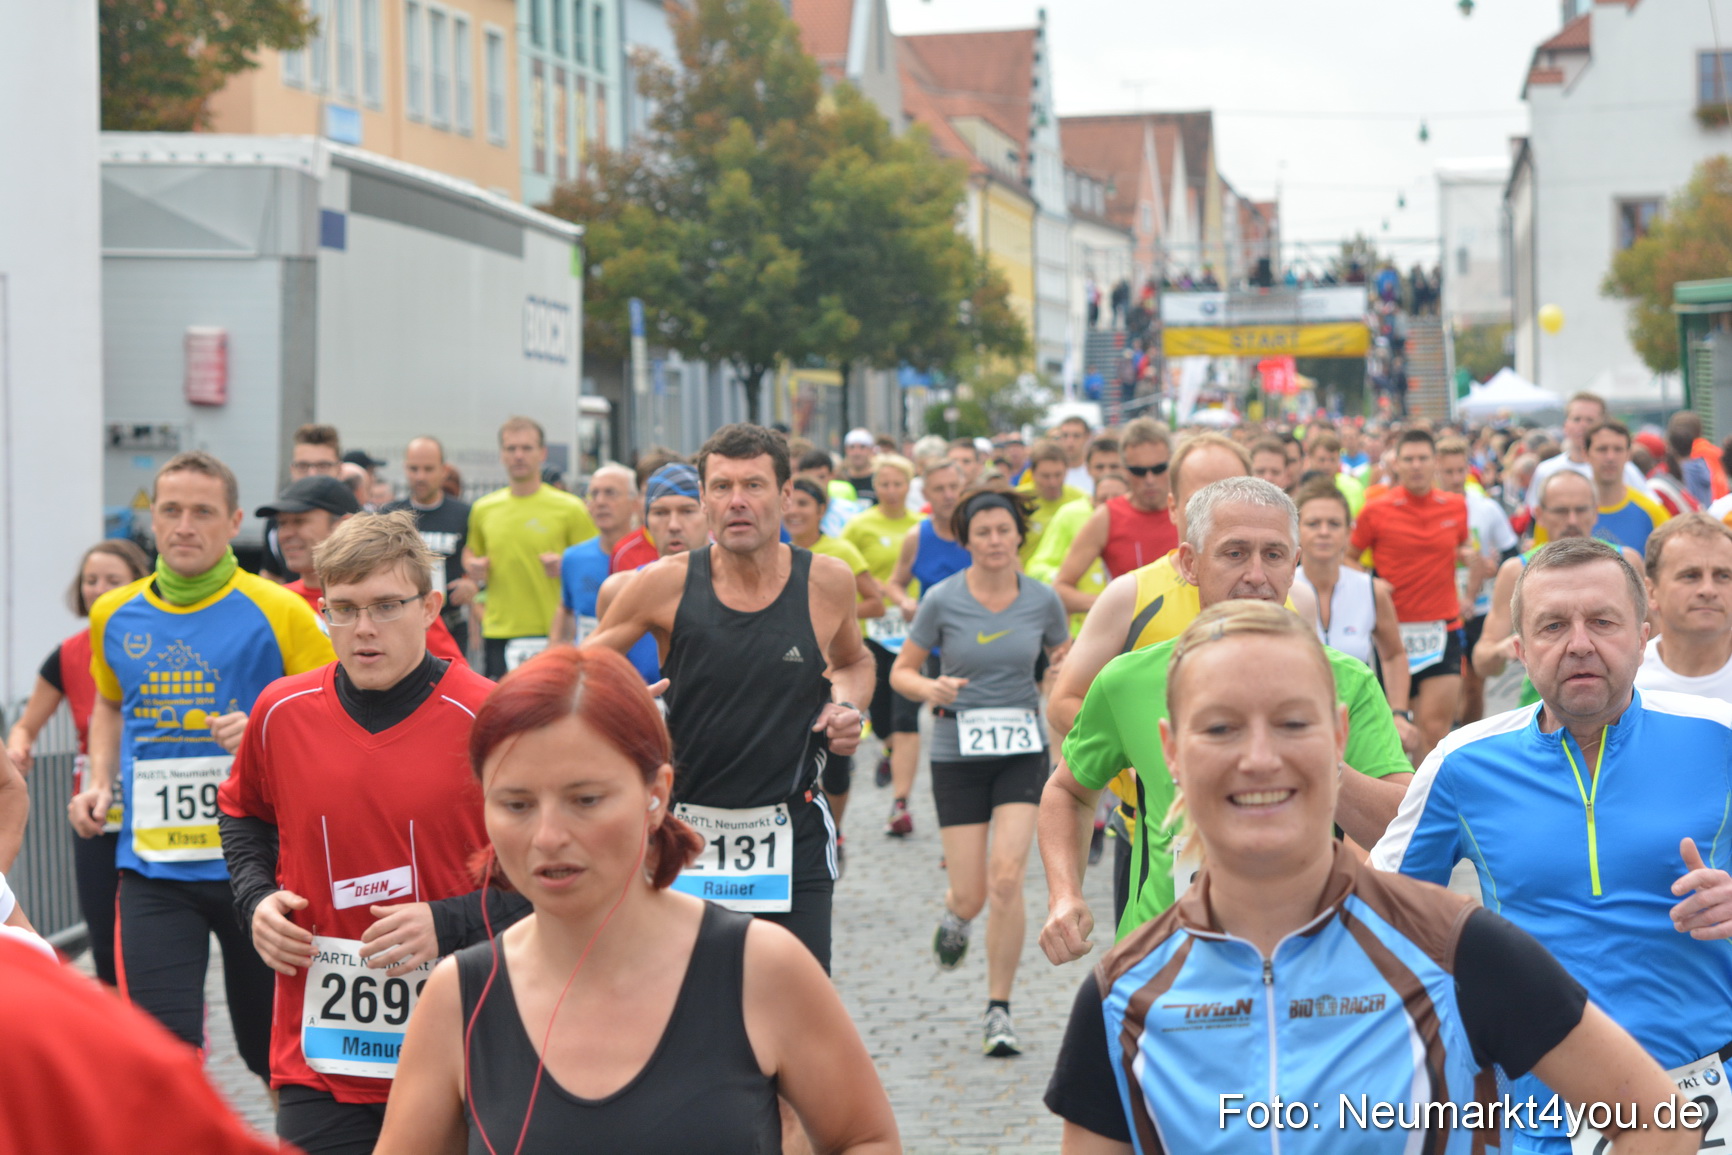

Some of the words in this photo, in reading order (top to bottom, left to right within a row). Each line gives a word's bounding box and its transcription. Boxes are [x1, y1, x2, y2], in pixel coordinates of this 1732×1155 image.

[1231, 333, 1299, 348] START
[969, 727, 1032, 750] 2173
[169, 767, 222, 779] Neumarkt
[155, 783, 219, 821] 159
[715, 817, 771, 830] Neumarkt
[168, 831, 207, 846] Klaus
[684, 831, 776, 871] 131
[355, 879, 390, 897] DEHN
[703, 881, 756, 896] Rainer
[313, 951, 357, 967] PARTL
[320, 972, 428, 1026] 269
[1339, 993, 1387, 1016] RACER
